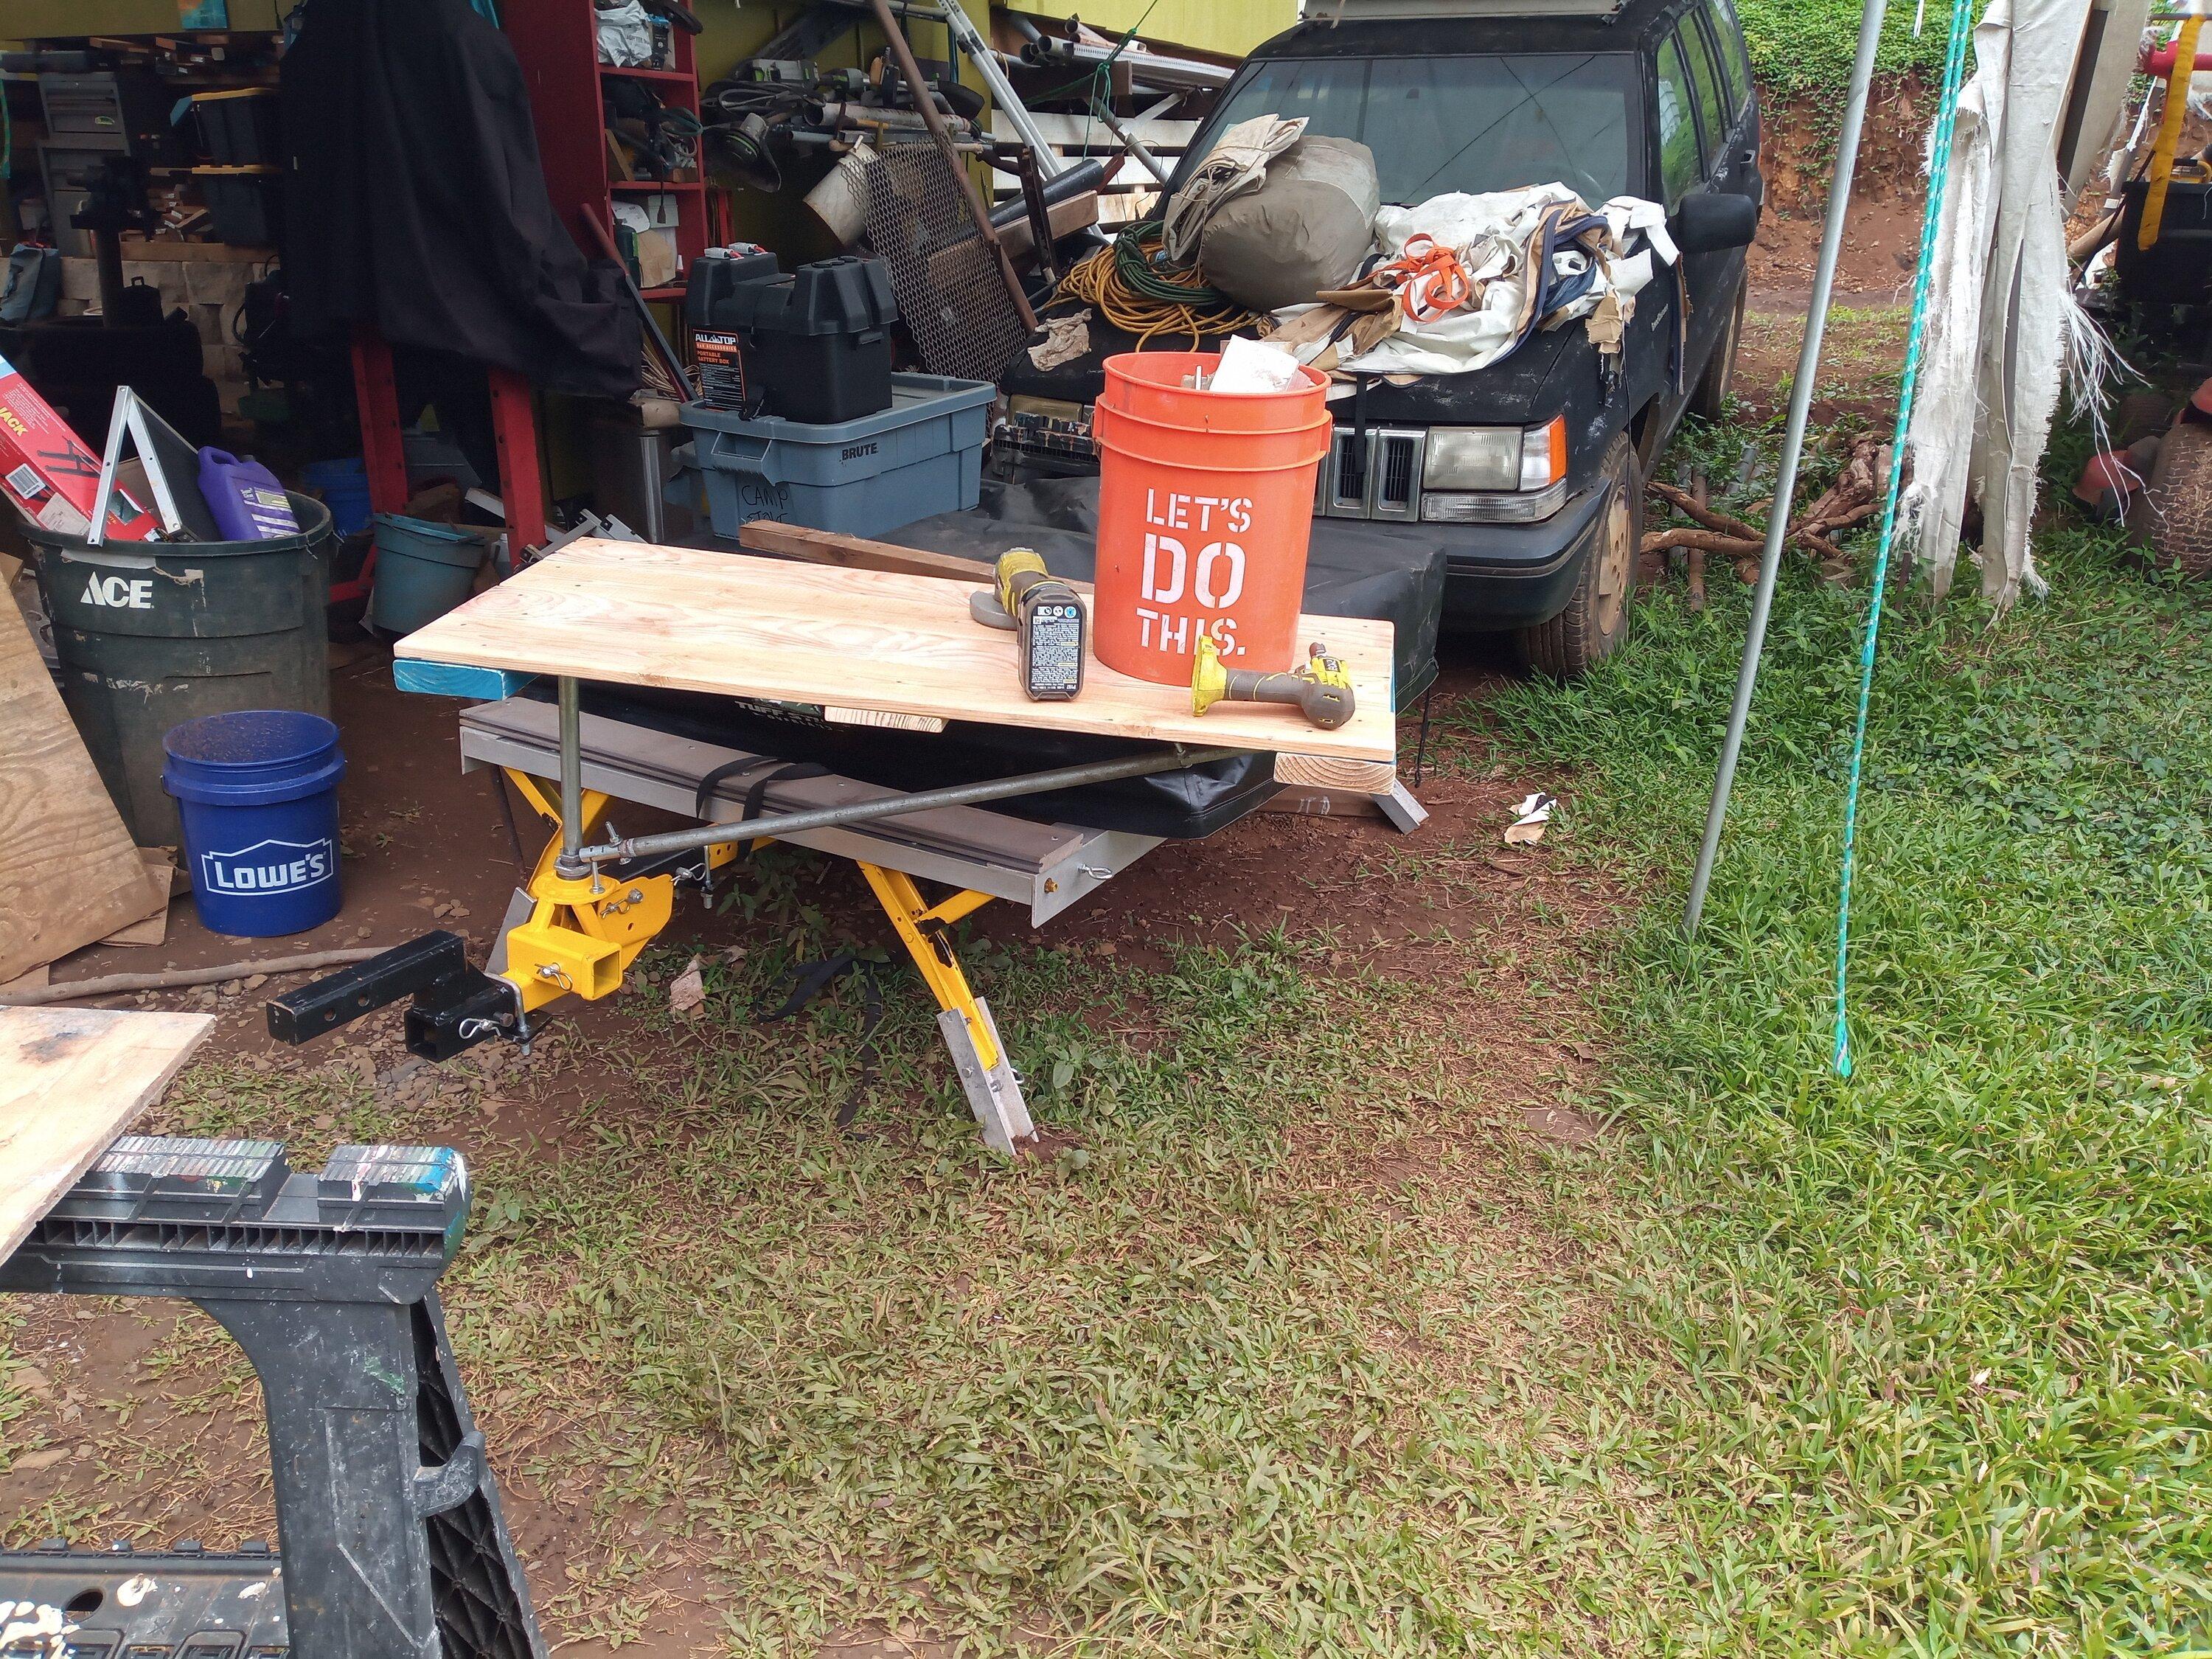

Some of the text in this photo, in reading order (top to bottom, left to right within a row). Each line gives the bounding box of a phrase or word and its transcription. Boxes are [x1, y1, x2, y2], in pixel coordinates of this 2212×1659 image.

[842, 442, 878, 461] BRUTE
[742, 485, 788, 509] CAMP
[1146, 487, 1253, 534] LET'S
[80, 571, 153, 609] ACE
[1141, 532, 1247, 610] DO
[1136, 607, 1247, 656] THIS.
[214, 852, 326, 888] LOWE'S
